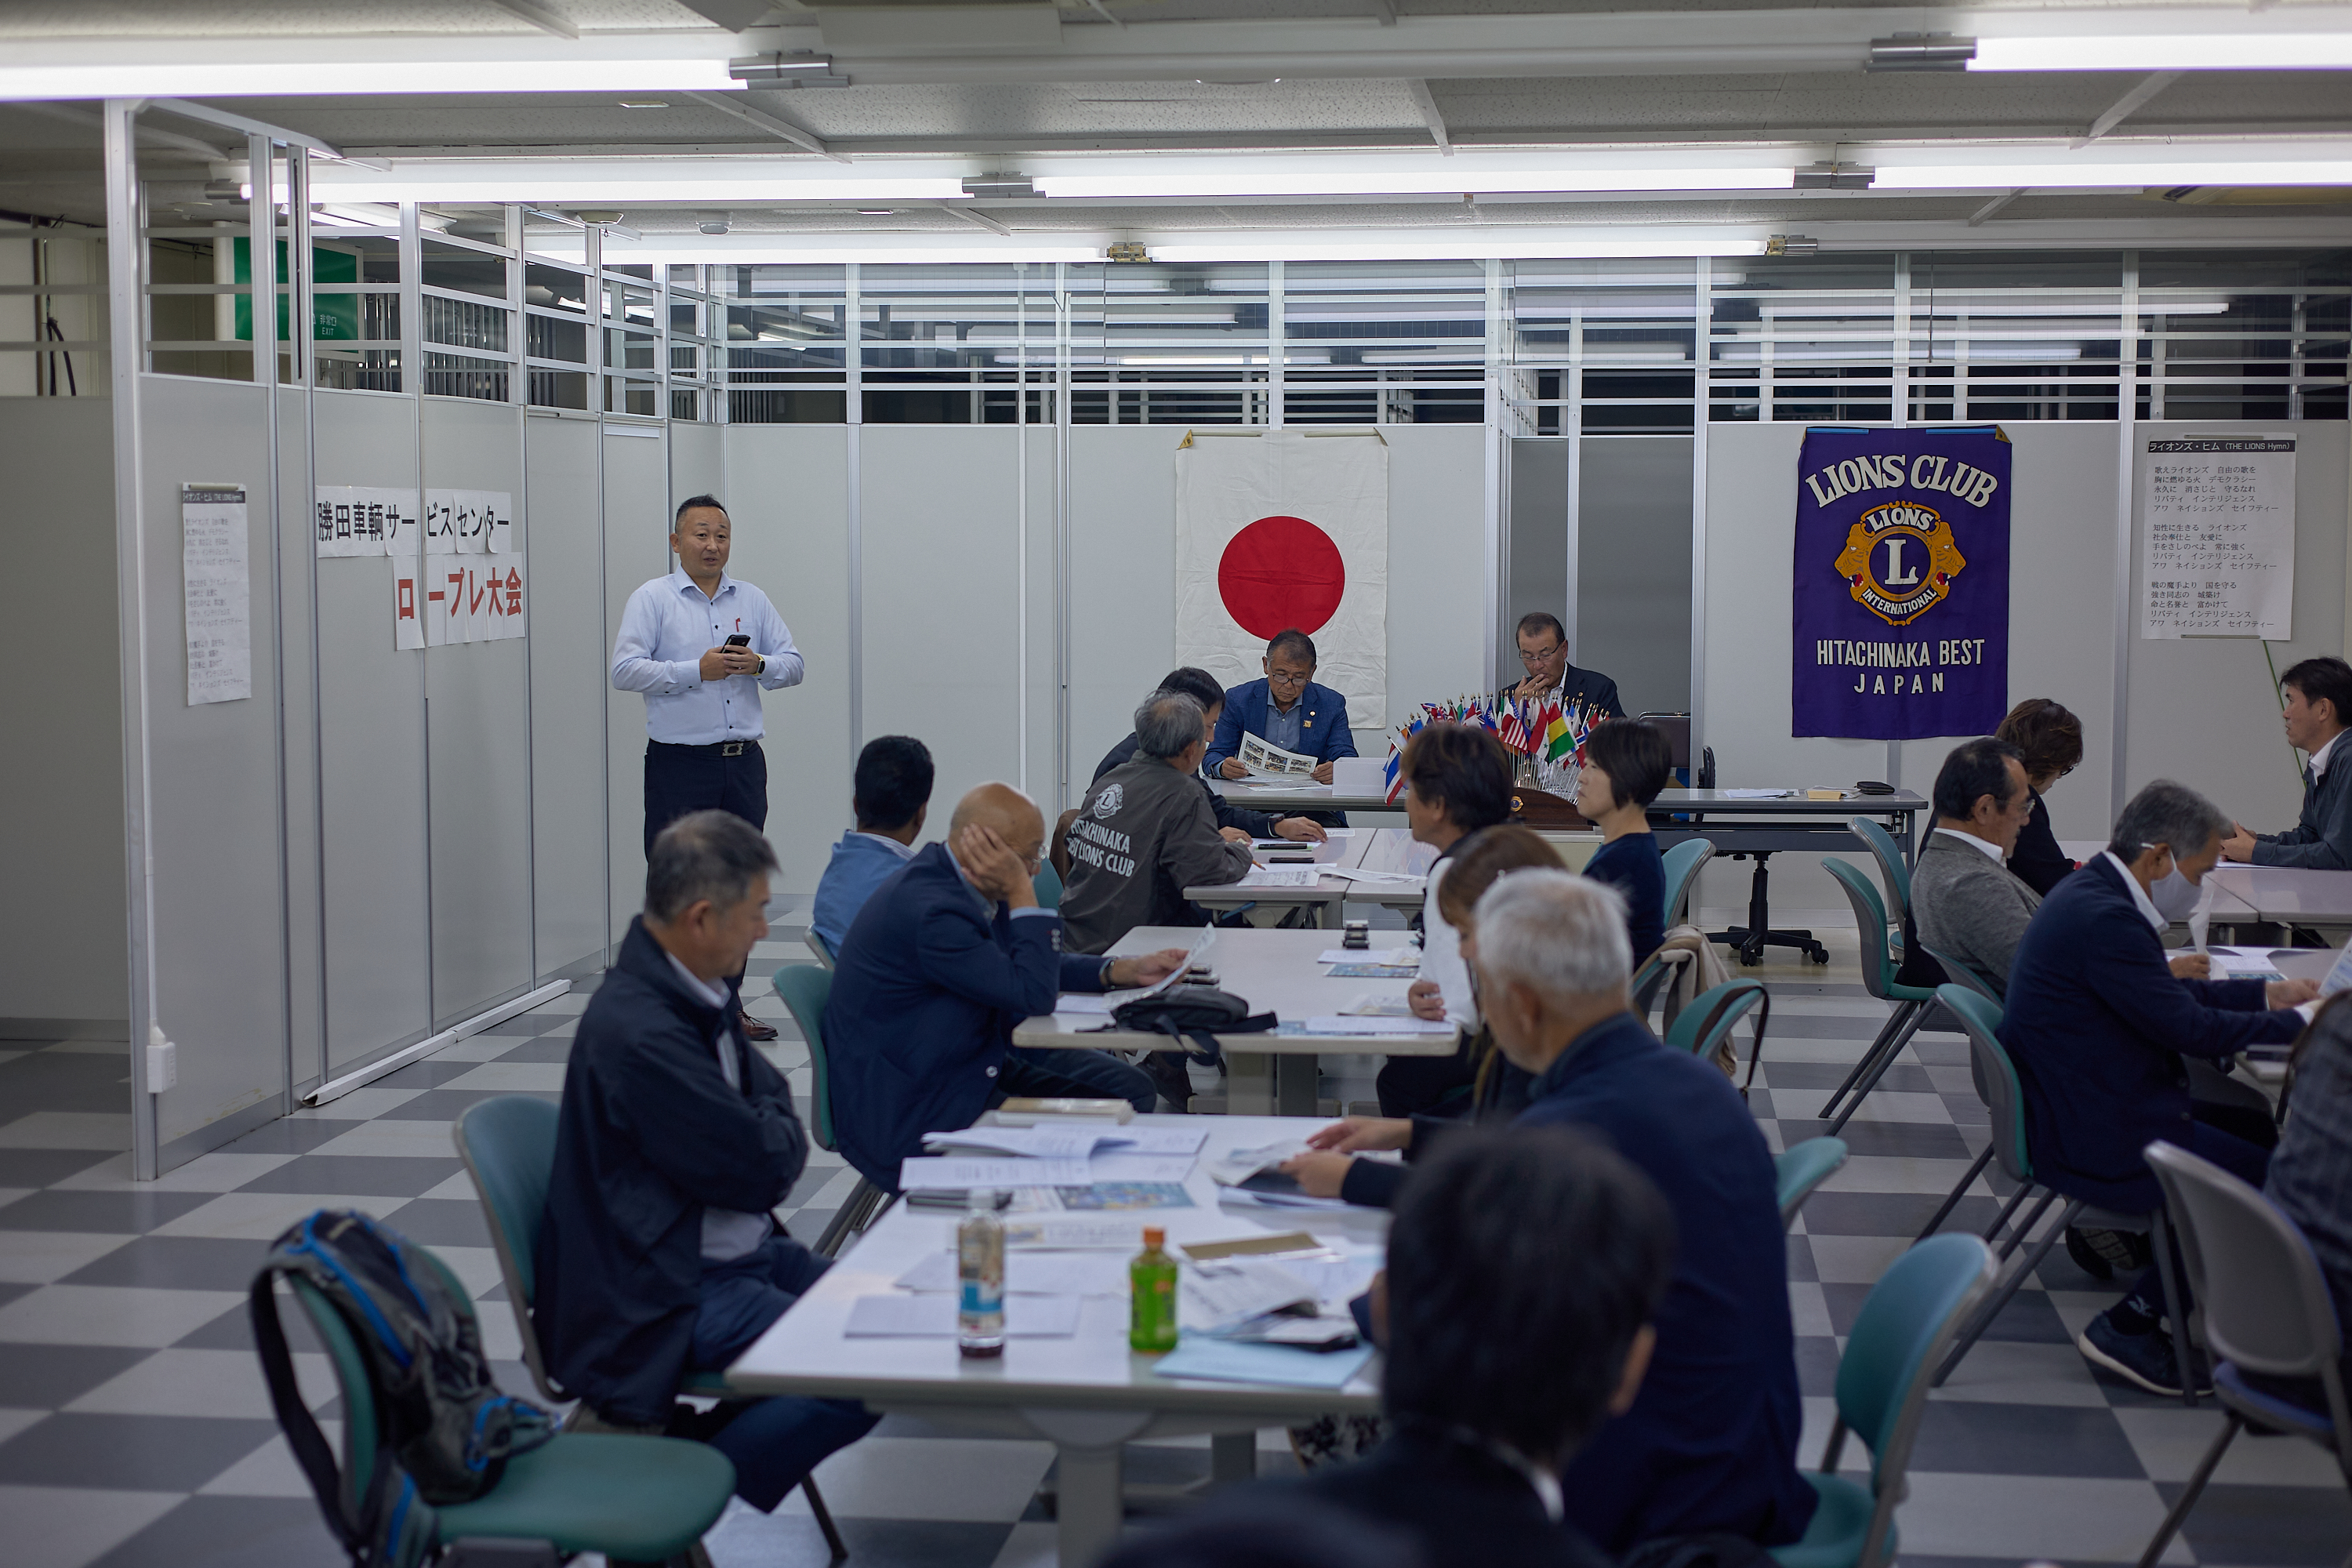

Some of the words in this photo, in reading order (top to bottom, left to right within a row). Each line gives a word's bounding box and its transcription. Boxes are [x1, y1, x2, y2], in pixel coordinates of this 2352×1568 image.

[320, 314, 337, 326] 非常口
[321, 327, 334, 336] EXIT
[2149, 442, 2220, 452] ライオンズ・ヒム
[2154, 466, 2209, 474] 歌えライオンズ
[2217, 466, 2256, 474] 自由の歌を
[1806, 454, 1906, 507] LIONS
[1911, 454, 1998, 507] CLUB
[2209, 475, 2256, 484] デモクラシー
[2177, 504, 2224, 513] ネイションズ
[1866, 507, 1934, 532] LIONS
[2199, 533, 2223, 542] 友愛に
[2215, 543, 2245, 551] 常に強く
[2190, 552, 2254, 561] インテリジェンス
[1884, 539, 1919, 585] L
[2175, 561, 2223, 570] ネイションズ
[2151, 581, 2198, 590] 戦の魔手より
[2205, 581, 2237, 590] 国を守る
[397, 565, 522, 620] ロープレ大会
[2151, 590, 2190, 599] 強き同志の
[2197, 590, 2220, 599] 城築け
[1862, 587, 1937, 615] INTERNATIONAL
[2151, 600, 2189, 608] 命と名誉と
[2189, 610, 2252, 619] インテリジェンス
[1817, 639, 1930, 668] HITACHINAKA
[1939, 638, 1985, 666] BEST
[1853, 672, 1944, 695] JAPAN
[1079, 841, 1105, 867] LIONS
[1105, 853, 1135, 877] CLUB
